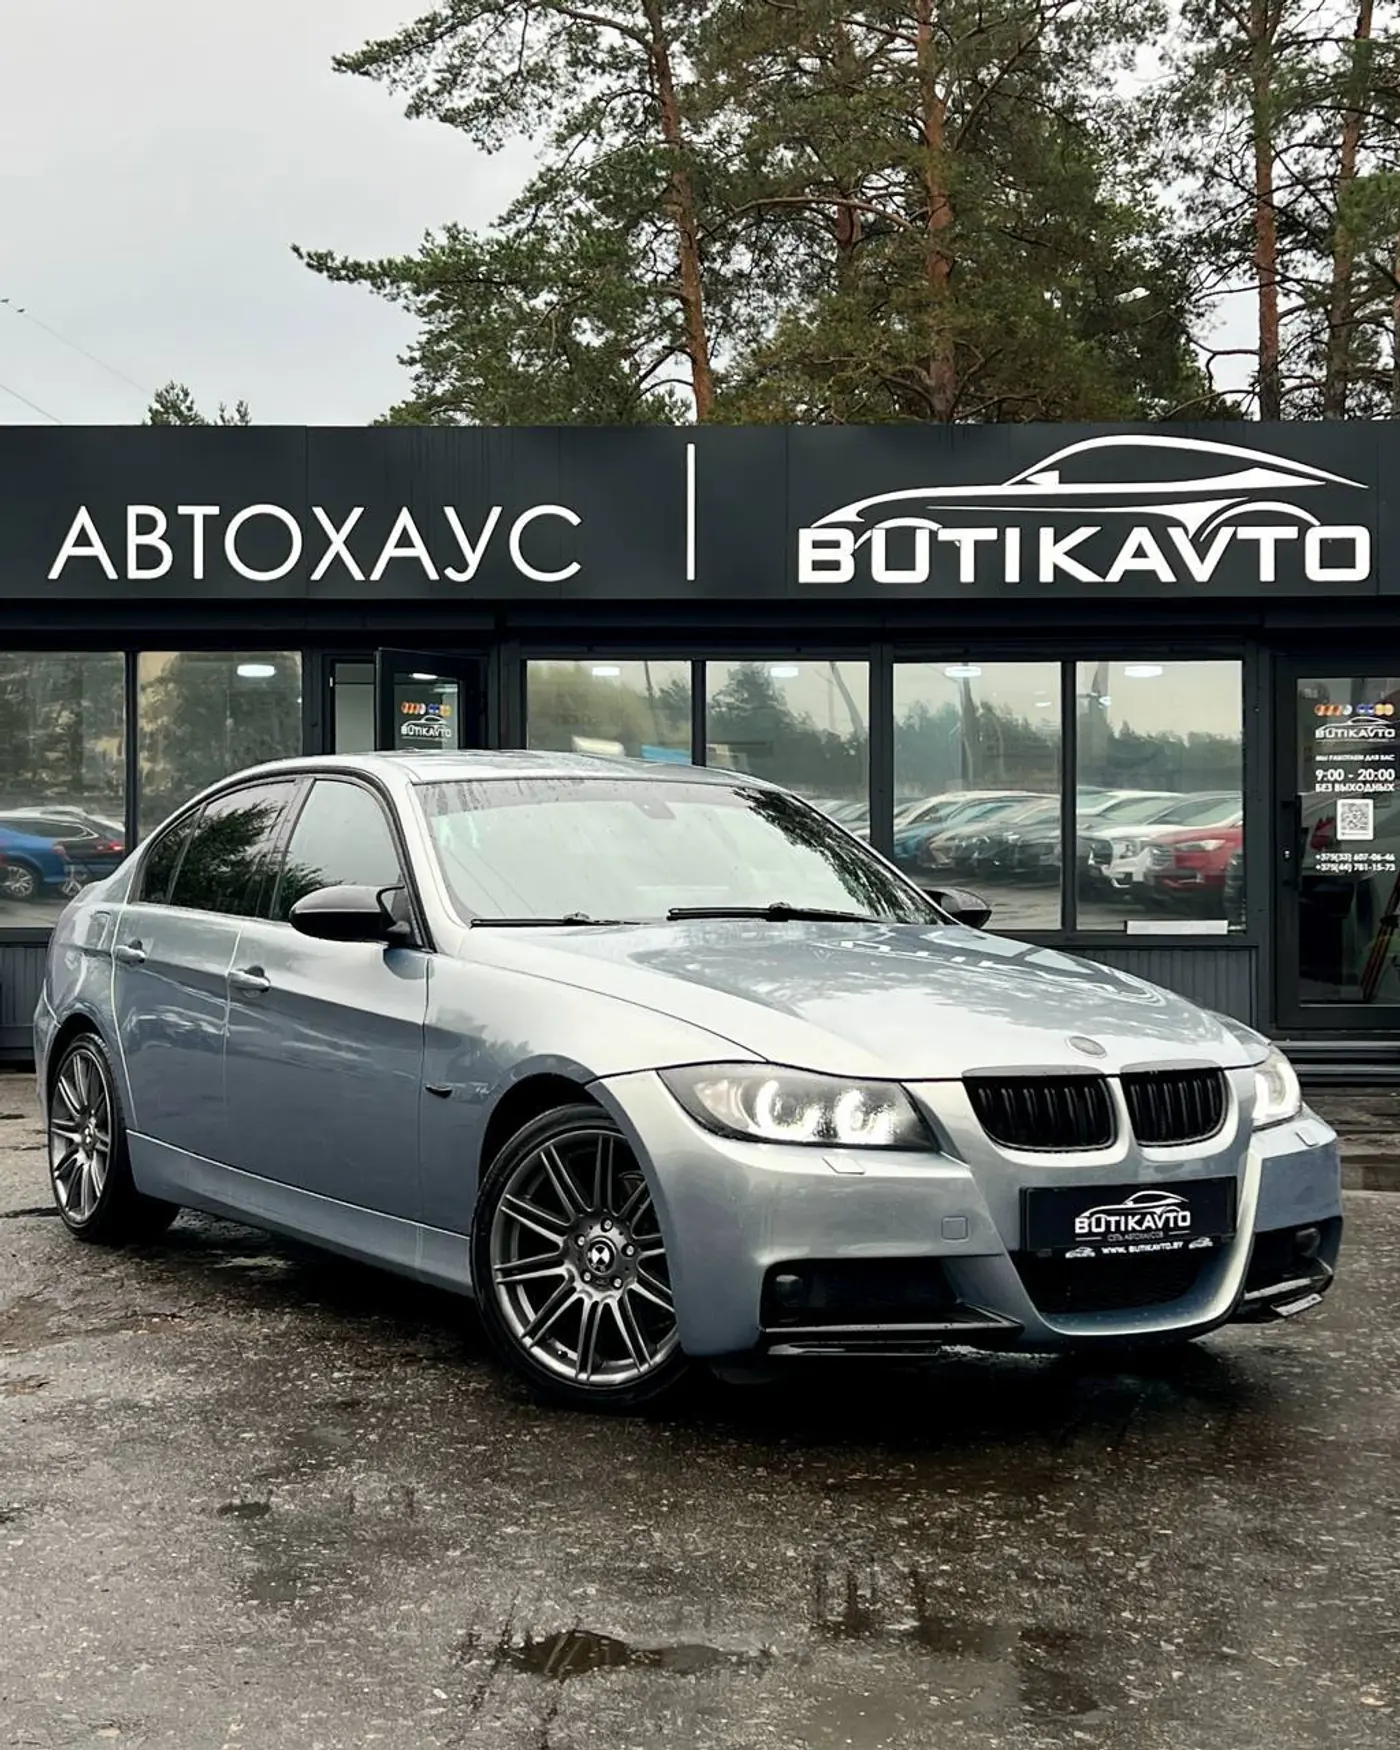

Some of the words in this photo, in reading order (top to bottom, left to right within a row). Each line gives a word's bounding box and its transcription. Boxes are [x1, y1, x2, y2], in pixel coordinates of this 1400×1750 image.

[48, 504, 582, 583] АВТОХАУС
[798, 525, 1371, 584] BUTIKAVTO
[401, 725, 452, 738] BUTIKAVTO
[1315, 728, 1396, 739] BUTIKAVTO
[1315, 768, 1345, 782] 9:00
[1357, 768, 1396, 781] 20:00
[1315, 783, 1333, 792] БЕЗ
[1334, 783, 1395, 793] ВЫХОДНЫХ
[1074, 1211, 1191, 1234] BUTIKAVTO
